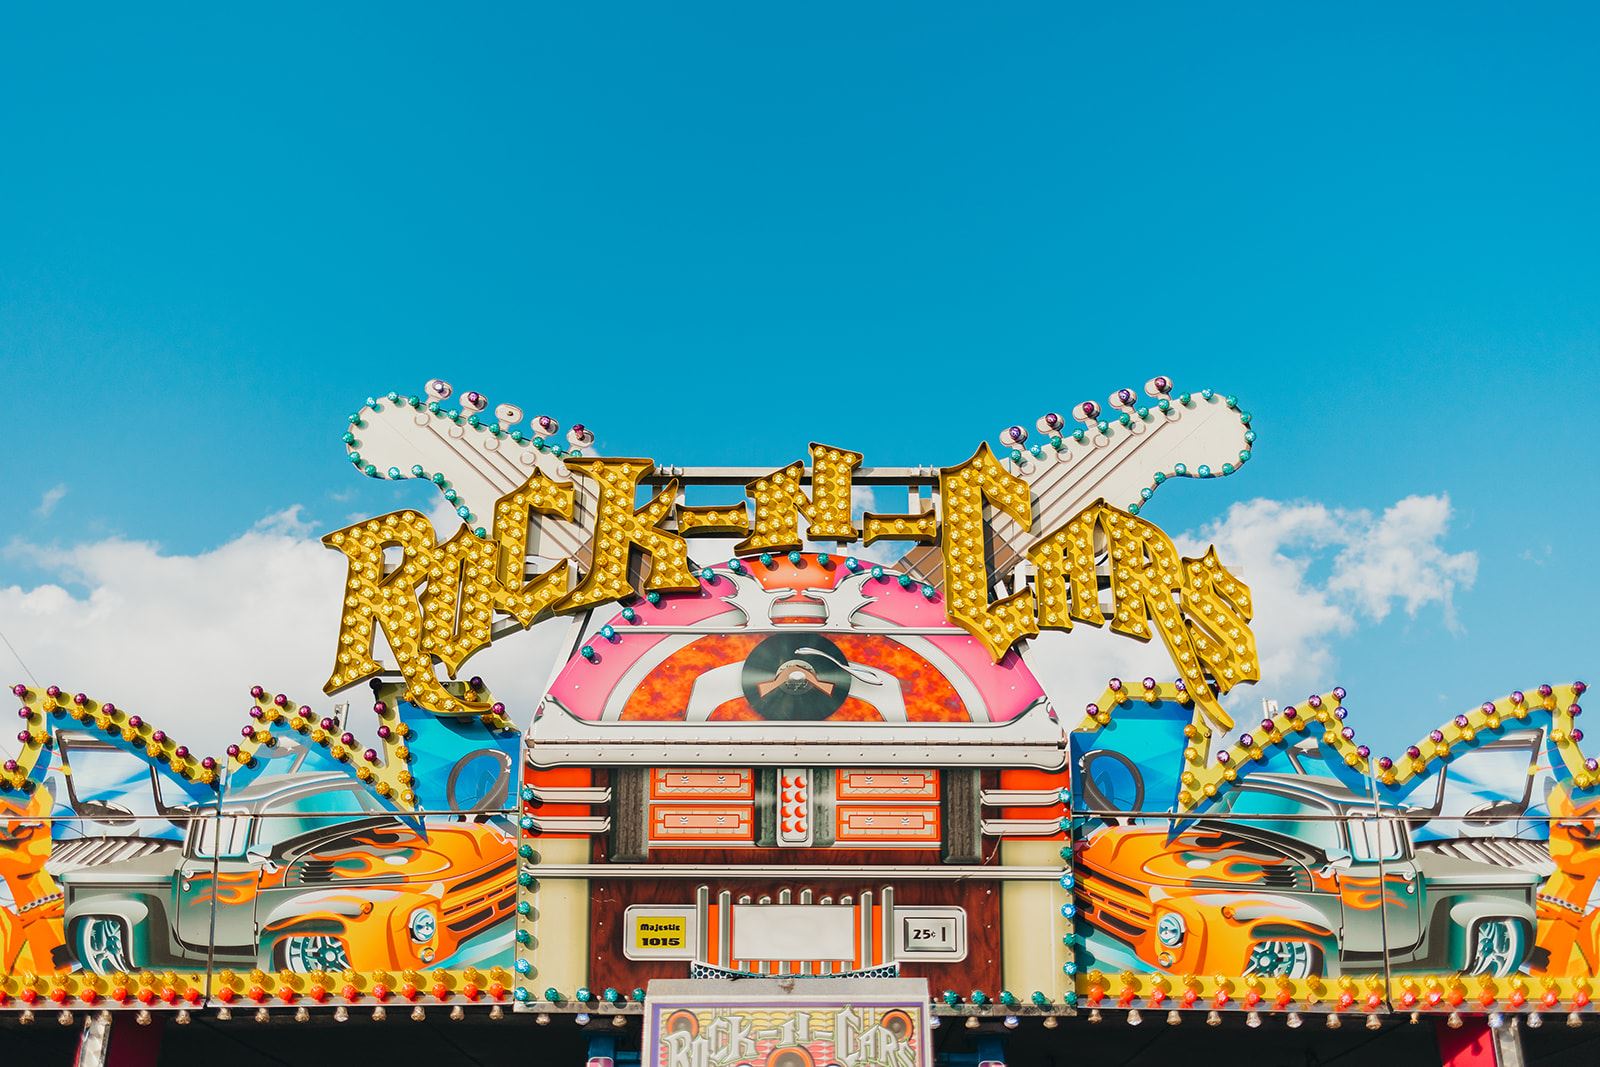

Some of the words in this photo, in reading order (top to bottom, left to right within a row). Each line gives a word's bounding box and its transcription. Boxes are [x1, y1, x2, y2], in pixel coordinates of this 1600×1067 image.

[640, 923, 681, 932] Majestic
[913, 929, 936, 940] 25¢
[641, 937, 680, 946] 1015
